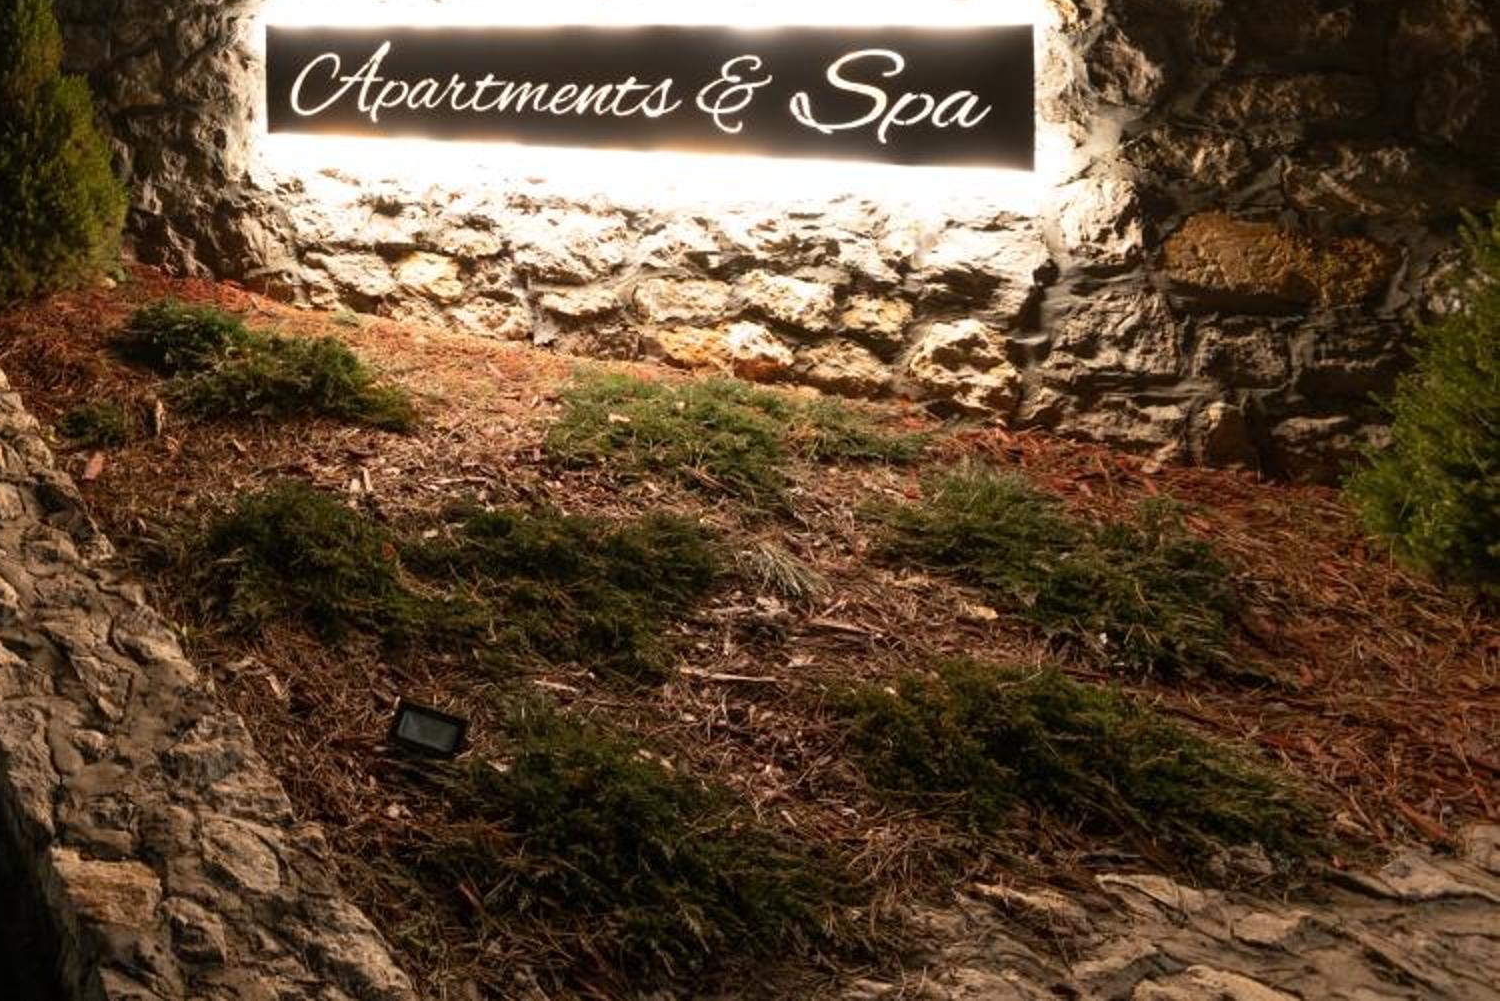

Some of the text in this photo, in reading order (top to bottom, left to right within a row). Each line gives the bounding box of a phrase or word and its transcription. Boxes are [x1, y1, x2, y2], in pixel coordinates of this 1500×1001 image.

[290, 41, 992, 143] Apartments & Spa
